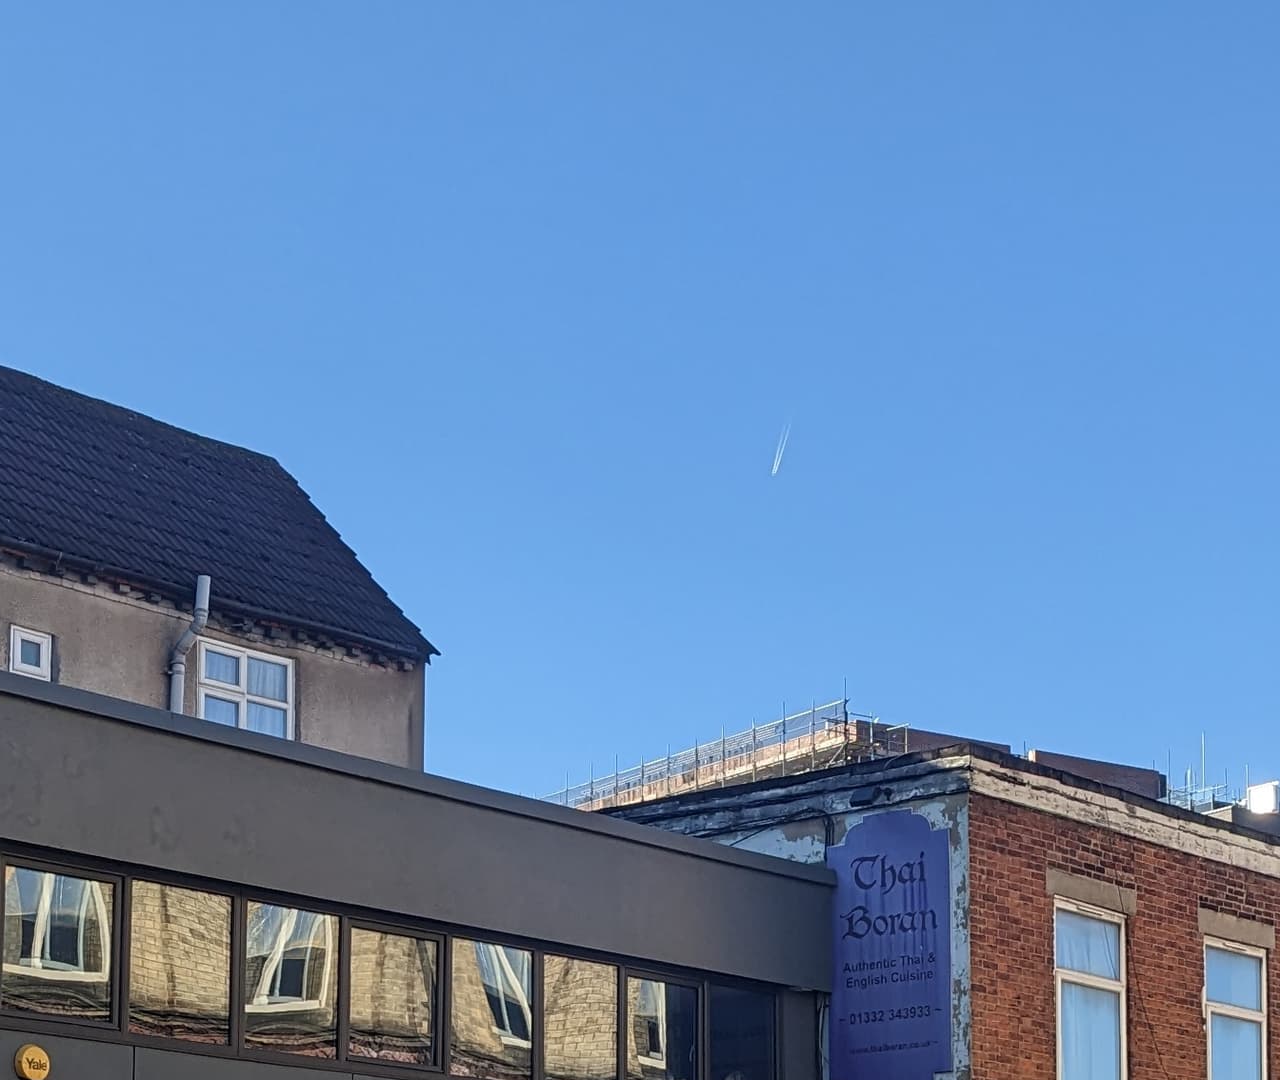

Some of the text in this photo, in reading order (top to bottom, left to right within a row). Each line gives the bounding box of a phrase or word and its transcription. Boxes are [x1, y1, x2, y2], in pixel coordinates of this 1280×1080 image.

[851, 851, 926, 895] Thai
[840, 906, 937, 940] Boran
[843, 951, 936, 973] Authentic Thai &
[845, 969, 933, 989] English Cuisine
[849, 1008, 885, 1025] 01332
[25, 1056, 47, 1071] Yale
